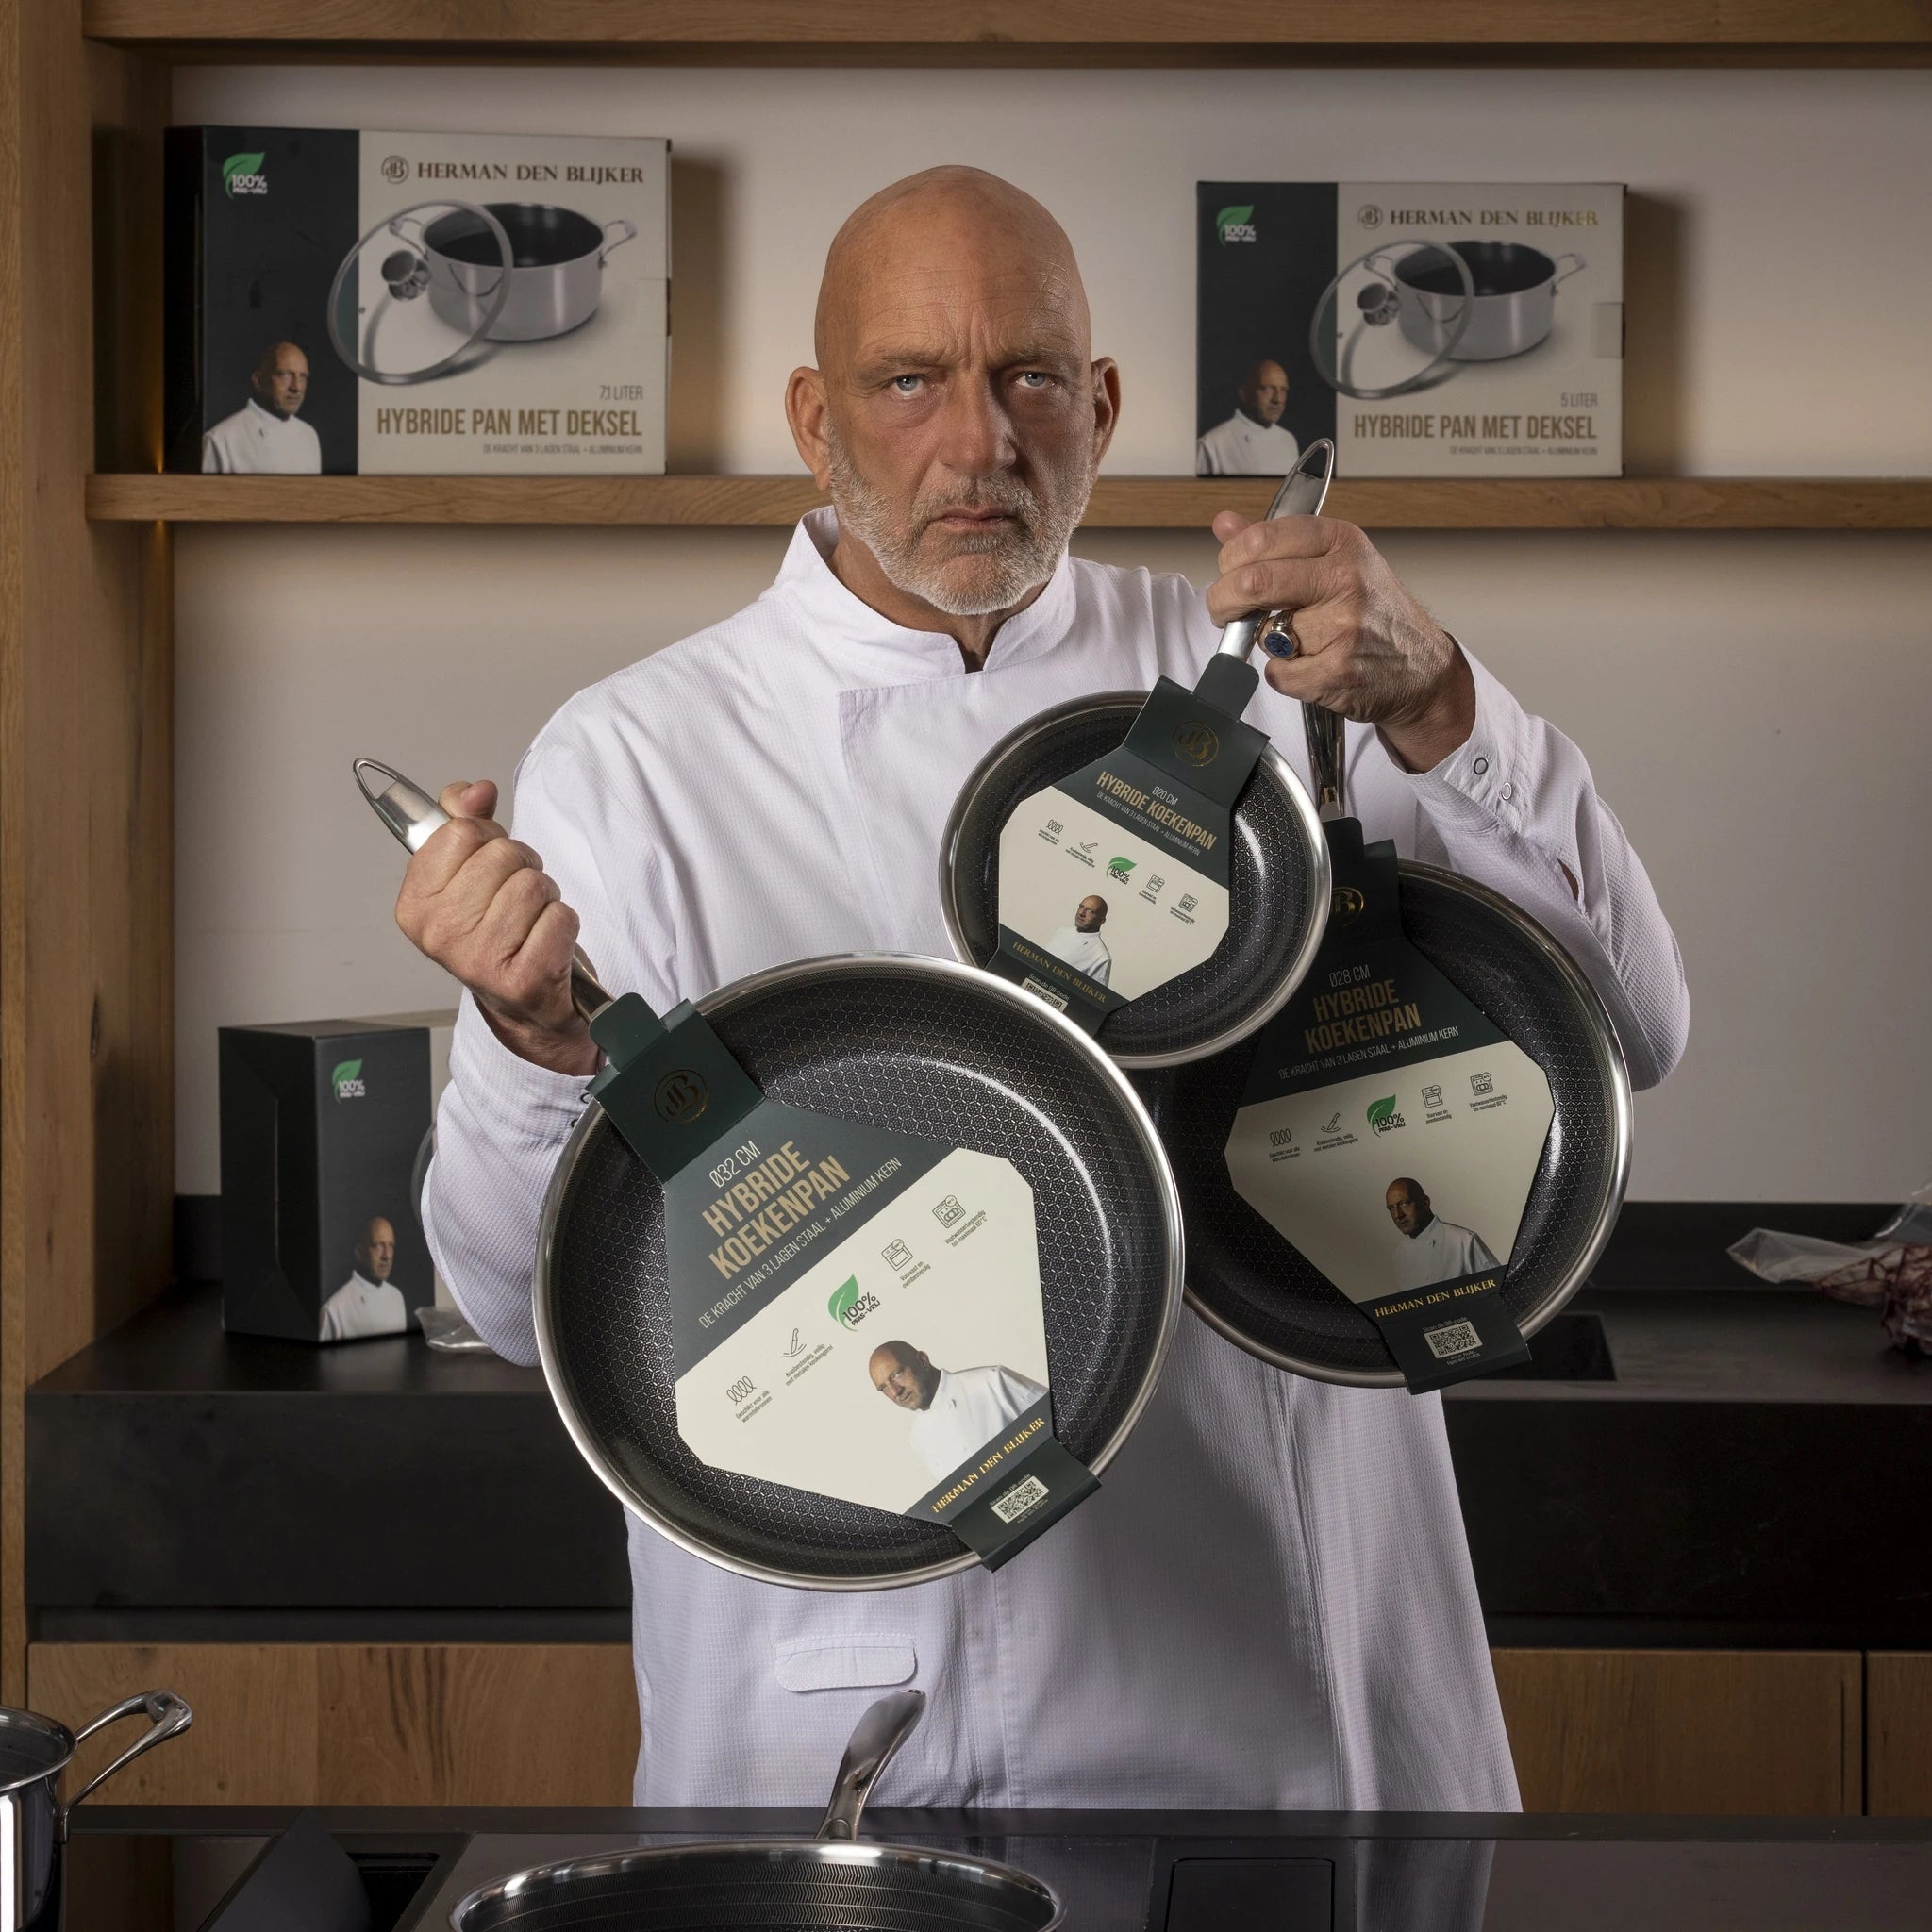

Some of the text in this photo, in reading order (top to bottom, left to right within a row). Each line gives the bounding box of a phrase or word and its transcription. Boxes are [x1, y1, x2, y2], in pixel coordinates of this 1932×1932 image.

[232, 175, 267, 188] 100%
[418, 162, 644, 185] HERMAN DEN BLIJKER
[1224, 225, 1256, 236] 100%
[1391, 209, 1599, 227] HERMAN DEN BLIJKER
[613, 385, 643, 401] LITER
[1561, 392, 1598, 408] 5 LITER
[377, 408, 642, 436] HYBRIDE PAN MET DEKSEL
[1354, 414, 1597, 439] HYBRIDE PAN MET DEKSEL
[1095, 770, 1217, 850] HYBRIDE KOEKENPAN
[1165, 793, 1178, 807] CM
[1110, 865, 1131, 882] 100%
[1011, 941, 1107, 1003] HERMAN DEN BLIJKER
[1028, 973, 1042, 984] Scan
[1327, 963, 1371, 988] Ø28 CM
[1311, 977, 1399, 1022] HYBRIDE
[1303, 1002, 1422, 1054] KOEKENPAN
[1278, 1067, 1291, 1079] DE
[1290, 1060, 1320, 1076] KRACHT
[1319, 1056, 1336, 1069] VAN
[1341, 1048, 1367, 1063] LAGEN
[1367, 1042, 1391, 1058] STAAL
[1396, 1030, 1438, 1050] ALUMINIUM
[1438, 1025, 1459, 1040] KERN
[1375, 1111, 1404, 1127] 100%
[708, 1139, 761, 1189] Ø32 CM
[701, 1139, 810, 1238] HYBRIDE
[708, 1154, 851, 1280] KOEKENPAN
[698, 1312, 716, 1329] DE
[710, 1283, 748, 1318] KRACHT
[743, 1268, 767, 1291] VAN
[760, 1262, 774, 1276] 3
[768, 1240, 801, 1270] LAGEN
[795, 1218, 826, 1248] STAAL
[828, 1174, 880, 1221] ALUMINIUM
[874, 1156, 903, 1183] KERN
[841, 1290, 876, 1322] 100%
[1374, 1278, 1496, 1317] HERMAN DEN BLIJKER
[850, 1299, 881, 1325] PFAS-VRIJ
[931, 1471, 979, 1513] HERMAN
[978, 1451, 1003, 1474] DEN
[1003, 1416, 1046, 1455] BLIJKER
